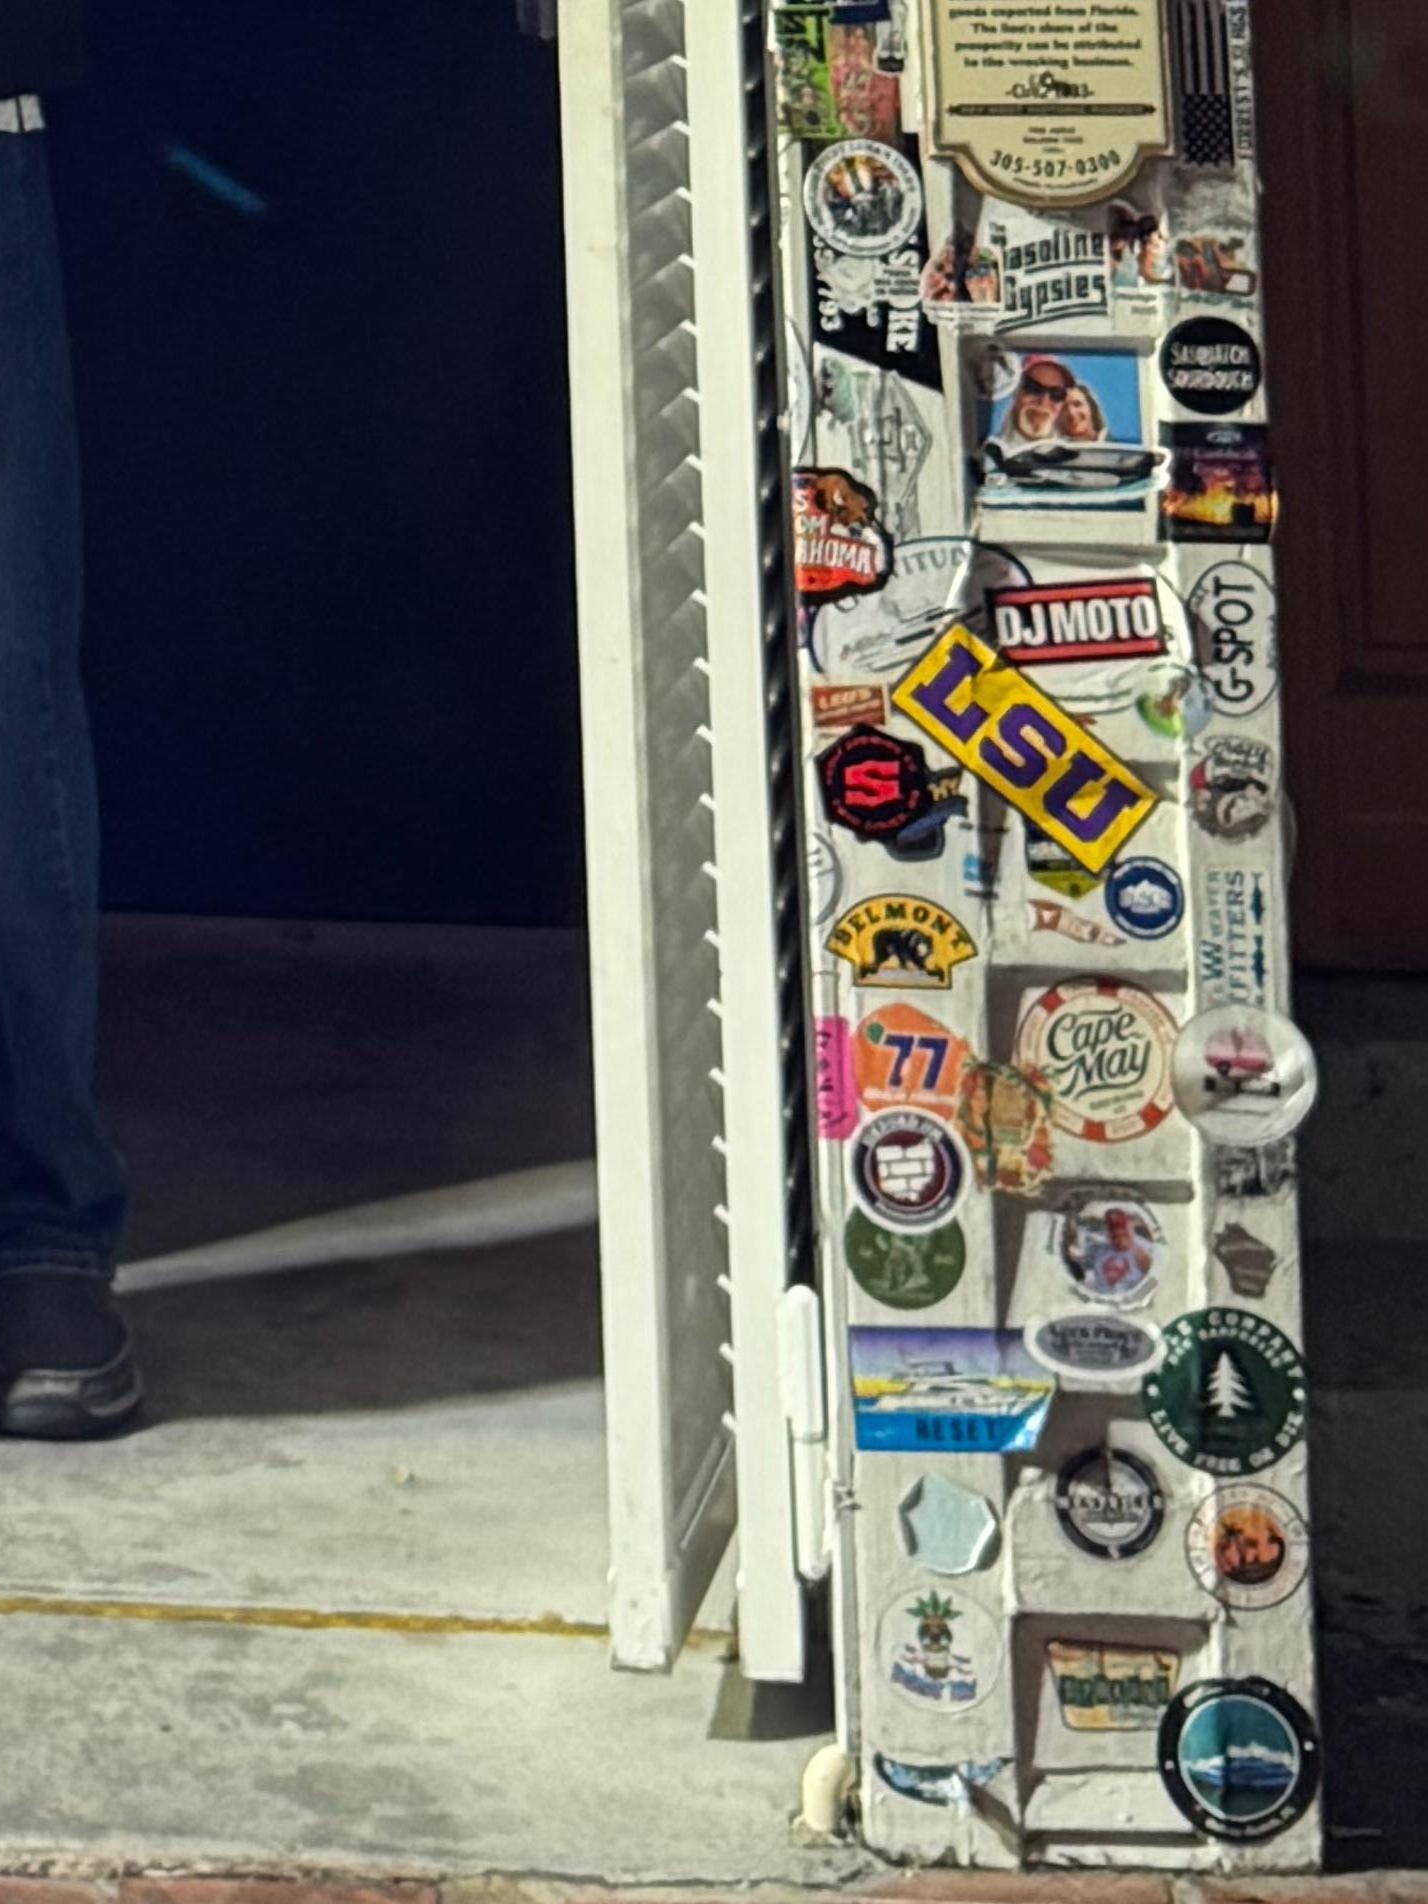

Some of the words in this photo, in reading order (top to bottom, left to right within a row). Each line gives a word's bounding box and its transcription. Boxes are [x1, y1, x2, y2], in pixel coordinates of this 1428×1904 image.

[990, 149, 1122, 177] 305-507-0300
[996, 606, 1048, 646] DJ
[1050, 595, 1159, 644] MOTO
[1212, 576, 1255, 704] G-SPOT
[911, 644, 1143, 844] LSU
[1046, 1005, 1136, 1058] Cape
[884, 1035, 950, 1092] 77
[1064, 1038, 1151, 1094] May
[915, 1416, 999, 1442] RESET
[1151, 1409, 1190, 1458] LIVE
[1193, 1453, 1242, 1473] FREE
[1247, 1444, 1275, 1467] OR
[1274, 1410, 1303, 1448] DIE
